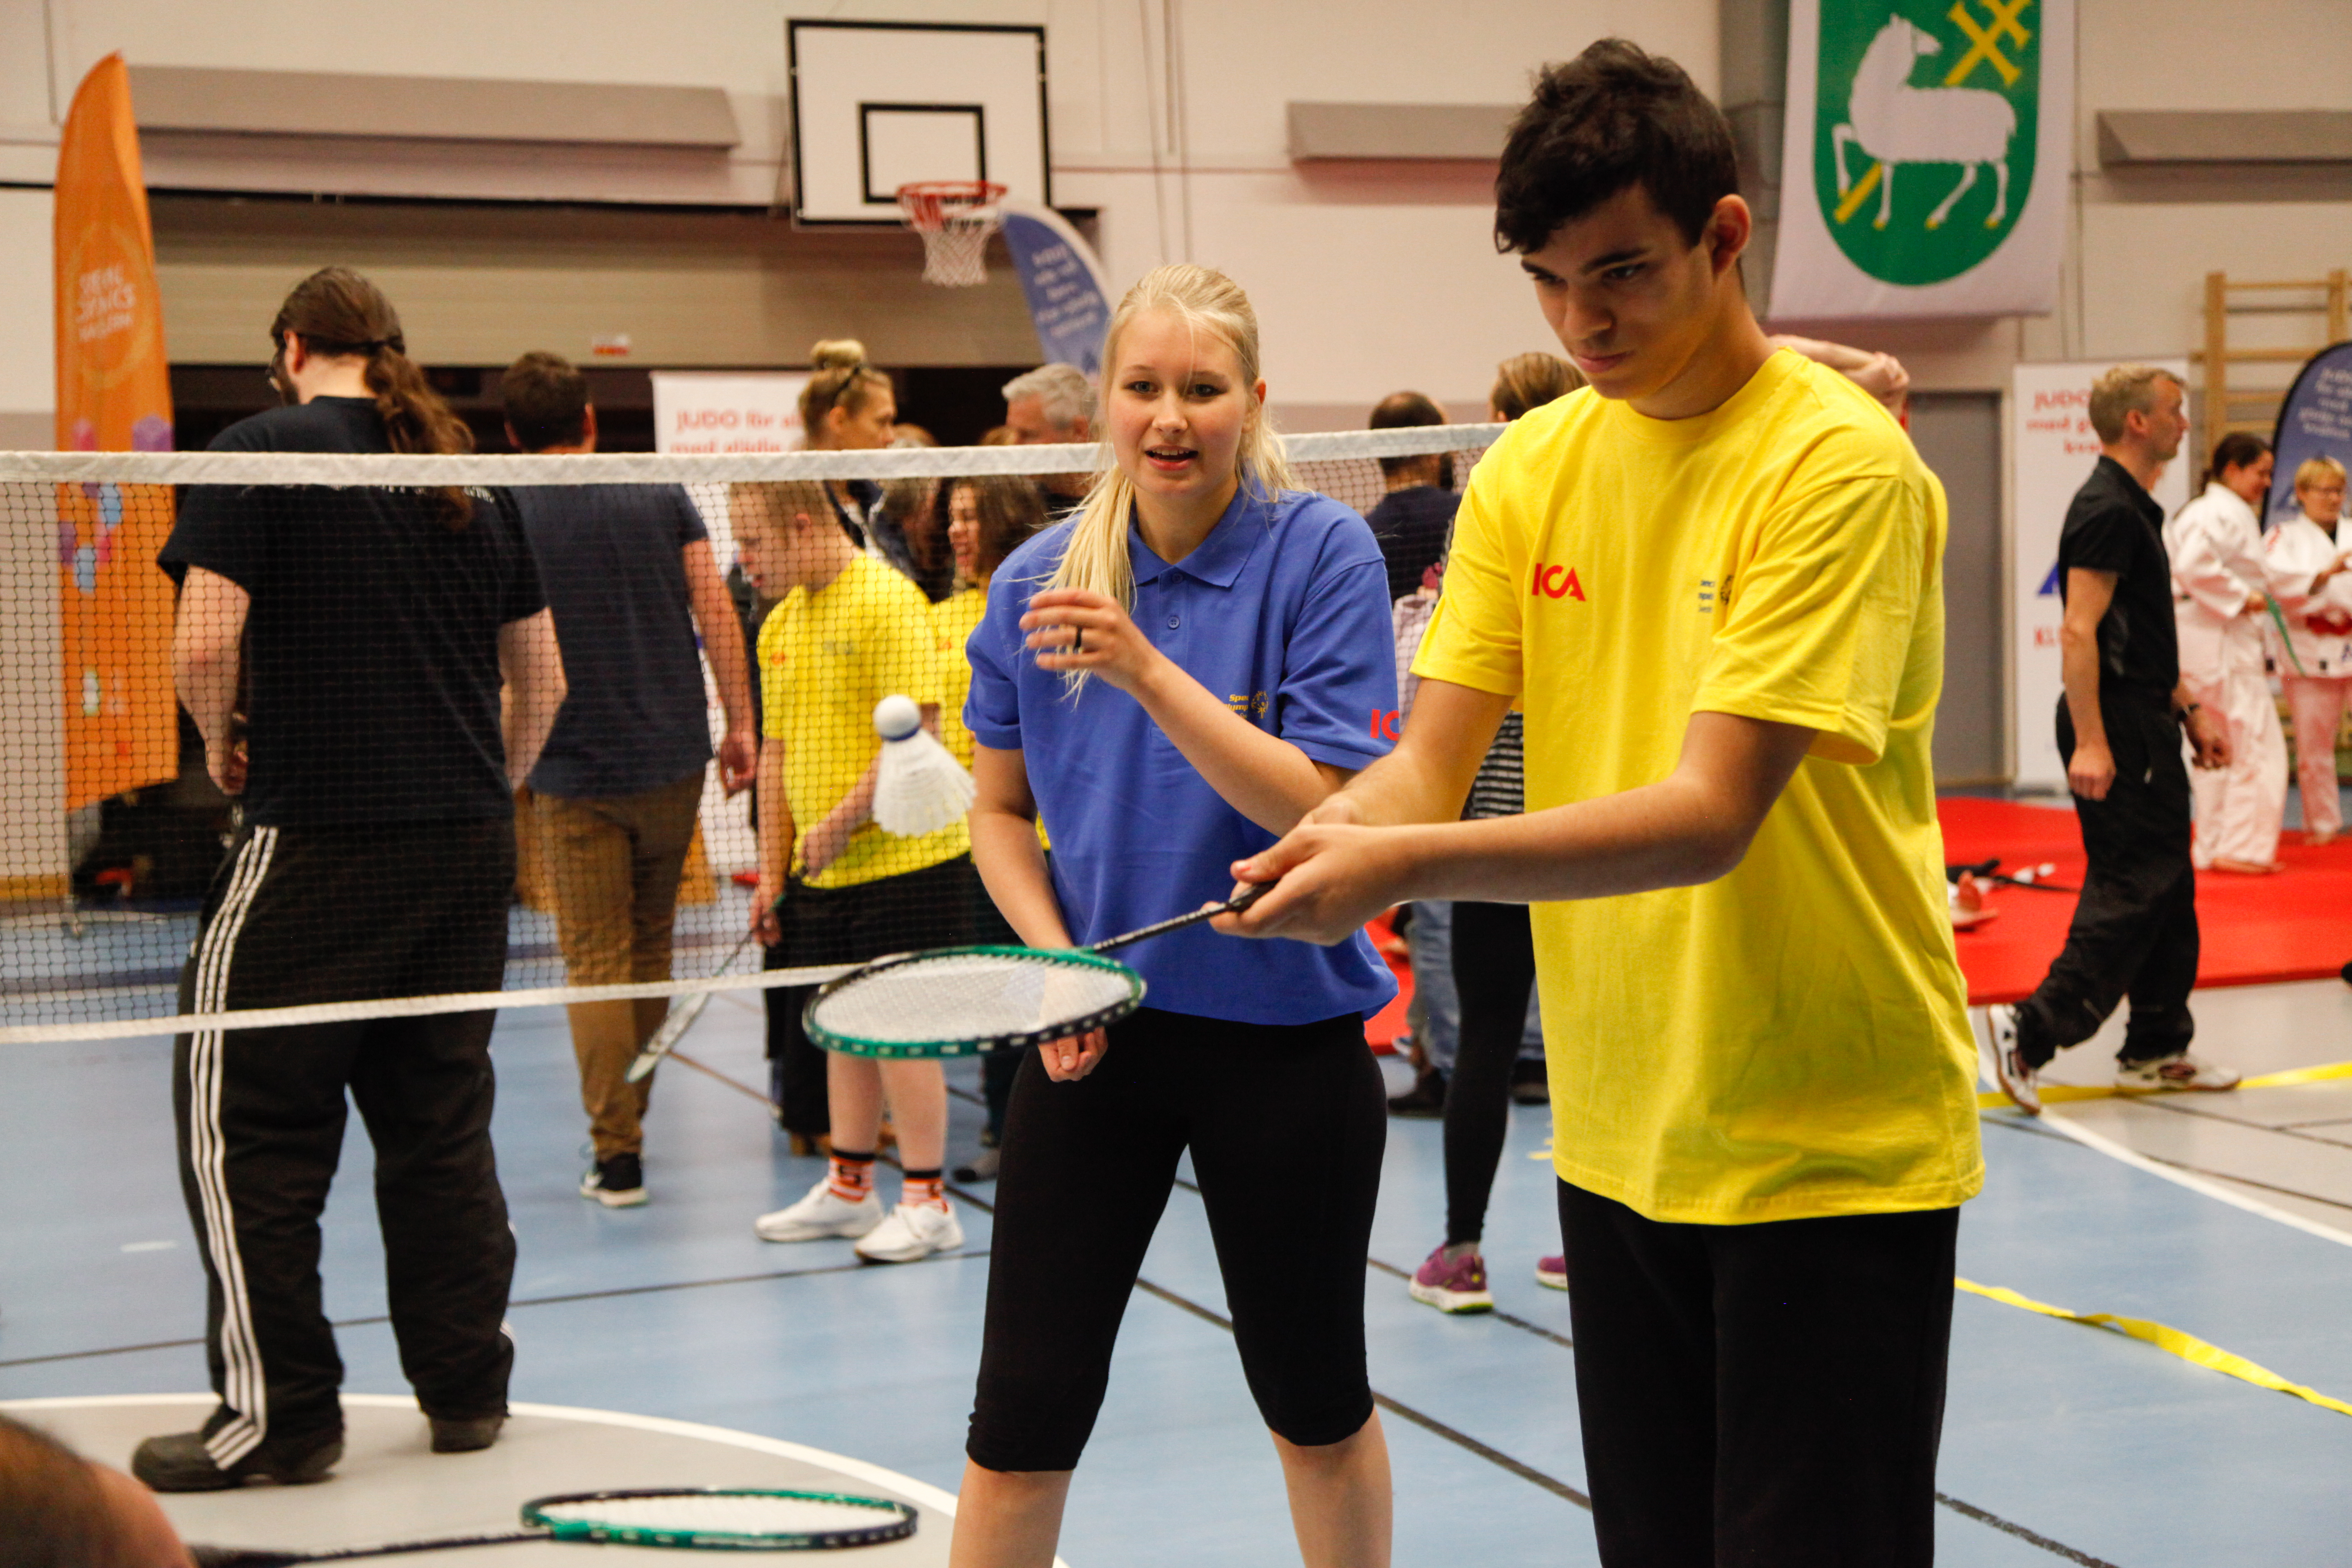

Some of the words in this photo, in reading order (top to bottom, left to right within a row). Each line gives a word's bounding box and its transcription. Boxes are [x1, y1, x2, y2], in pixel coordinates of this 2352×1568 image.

[675, 409, 740, 433] JUDO
[1532, 563, 1586, 601] ICA
[1369, 709, 1400, 741] IC
